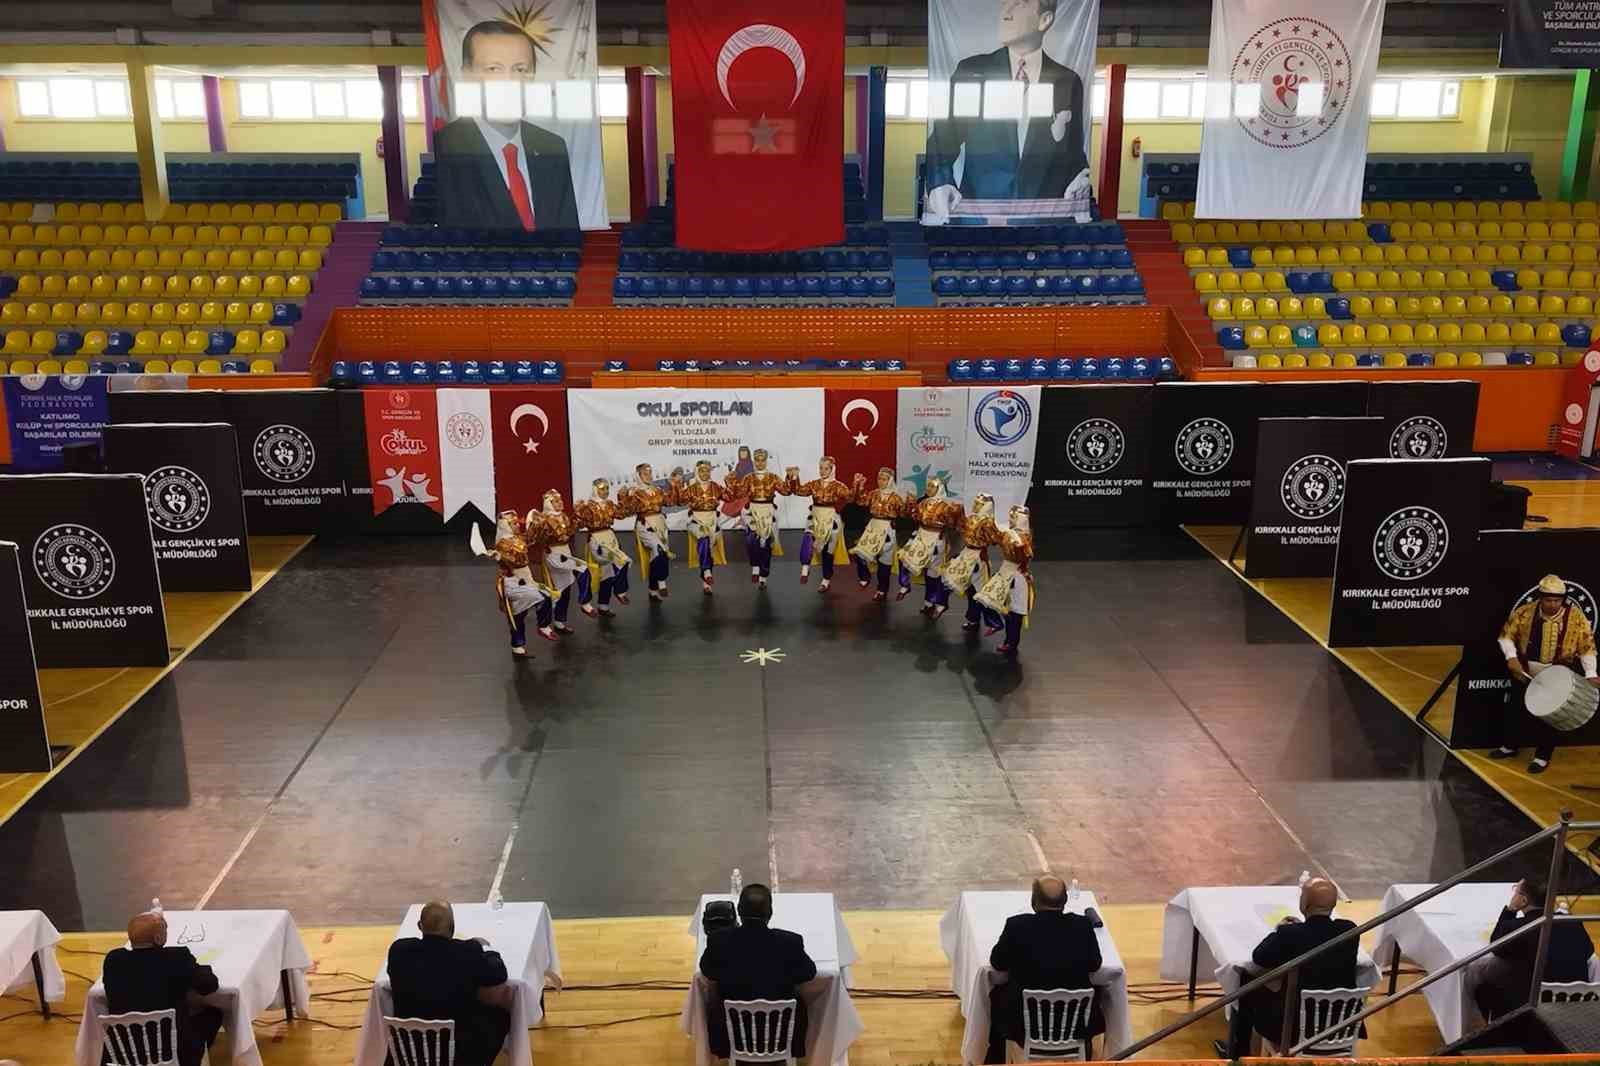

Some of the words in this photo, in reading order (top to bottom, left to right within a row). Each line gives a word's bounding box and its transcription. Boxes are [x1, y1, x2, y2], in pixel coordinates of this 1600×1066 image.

[1555, 11, 1600, 20] SPORCULA
[637, 402, 679, 417] OKUL
[680, 401, 753, 416] SPORLARI
[970, 470, 1028, 478] FEDERASYONU
[1044, 479, 1081, 487] KIRIKKALE
[1082, 478, 1112, 488] GENÇLİK
[1153, 480, 1190, 489] KIRIKKALE
[1191, 479, 1220, 489] GENÇLİK
[1221, 480, 1230, 488] VE
[1231, 480, 1251, 488] SPOR
[321, 487, 342, 495] SPOR
[1254, 527, 1296, 535] KIRIKKALE
[1297, 525, 1331, 536] GENÇLİK
[168, 538, 205, 548] GENÇLİK
[205, 539, 217, 547] VE
[217, 538, 240, 546] SPOR
[1281, 536, 1289, 545] İL
[1290, 535, 1340, 545] MÜDÜRLÜĞ
[163, 548, 217, 559] MÜDÜRLÜĞÜ
[1342, 589, 1391, 598] KIRIKKALE
[1391, 587, 1430, 599] GENÇLİK
[1431, 588, 1442, 597] VE
[1444, 587, 1470, 596] SPOR
[1371, 599, 1381, 610] İL
[1382, 598, 1441, 609] MÜDÜRLÜĞÜ
[26, 608, 68, 617] RIKKALE
[68, 606, 111, 618] GENÇLİK
[112, 607, 125, 615] VE
[127, 606, 153, 615] SPOR
[51, 619, 61, 630] İL
[62, 618, 127, 629] MÜDÜRLÜĞÜ
[1468, 679, 1512, 689] KIRIKKA
